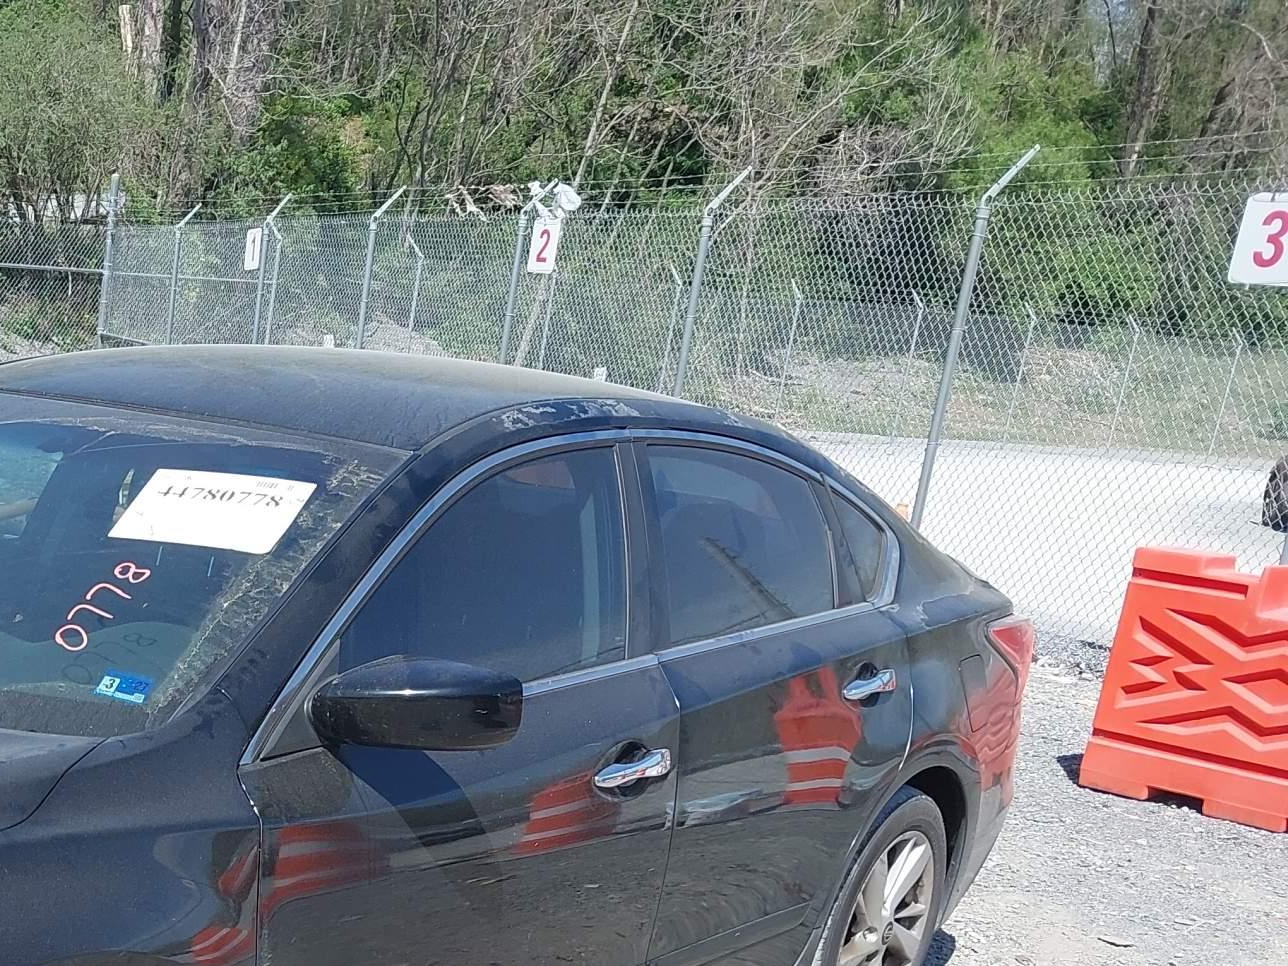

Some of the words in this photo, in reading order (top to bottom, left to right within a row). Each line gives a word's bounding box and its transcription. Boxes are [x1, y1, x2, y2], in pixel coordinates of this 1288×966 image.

[535, 228, 551, 263] 2
[1253, 210, 1288, 268] 3
[157, 484, 285, 508] 44780778
[54, 561, 152, 652] 0778
